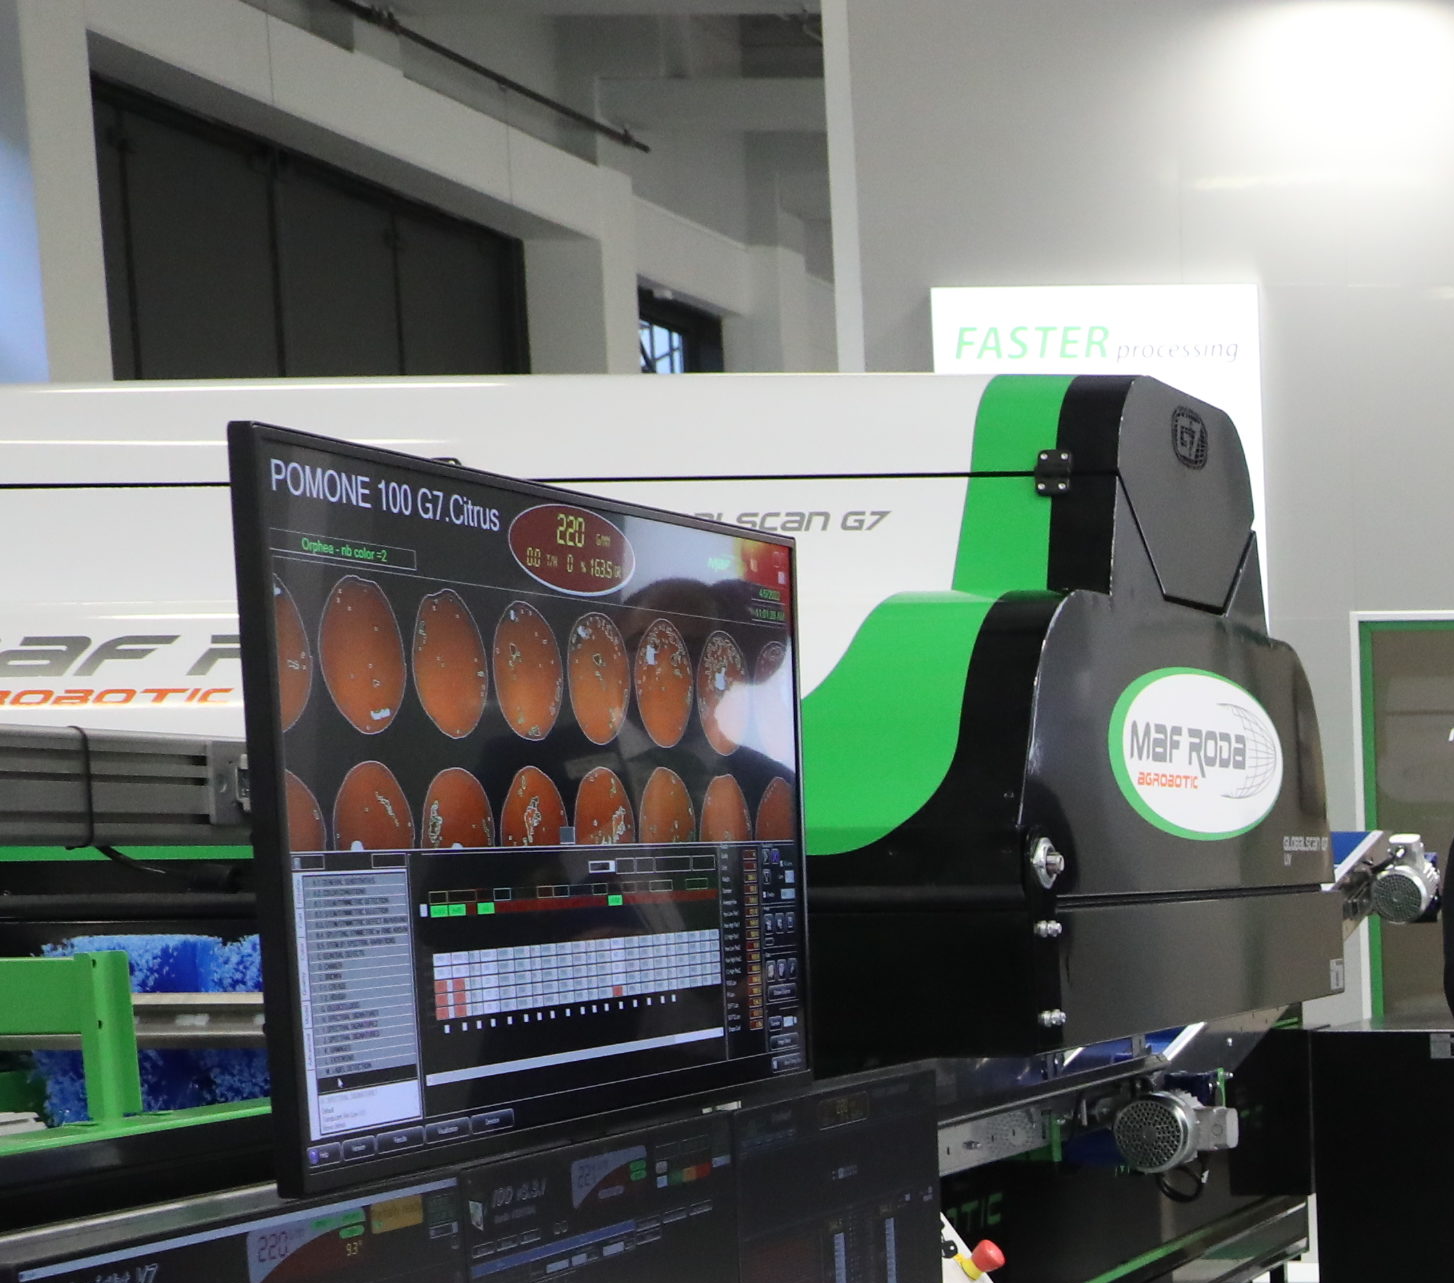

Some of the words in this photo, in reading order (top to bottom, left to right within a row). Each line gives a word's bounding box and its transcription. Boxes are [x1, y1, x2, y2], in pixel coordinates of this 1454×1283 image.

[955, 326, 1110, 360] FASTER
[1116, 341, 1239, 363] processing
[270, 459, 372, 508] POMONE
[378, 480, 412, 515] 100
[417, 488, 500, 531] G7.Citrus
[556, 513, 585, 547] 220
[841, 511, 892, 531] G7
[302, 537, 334, 555] Orphea
